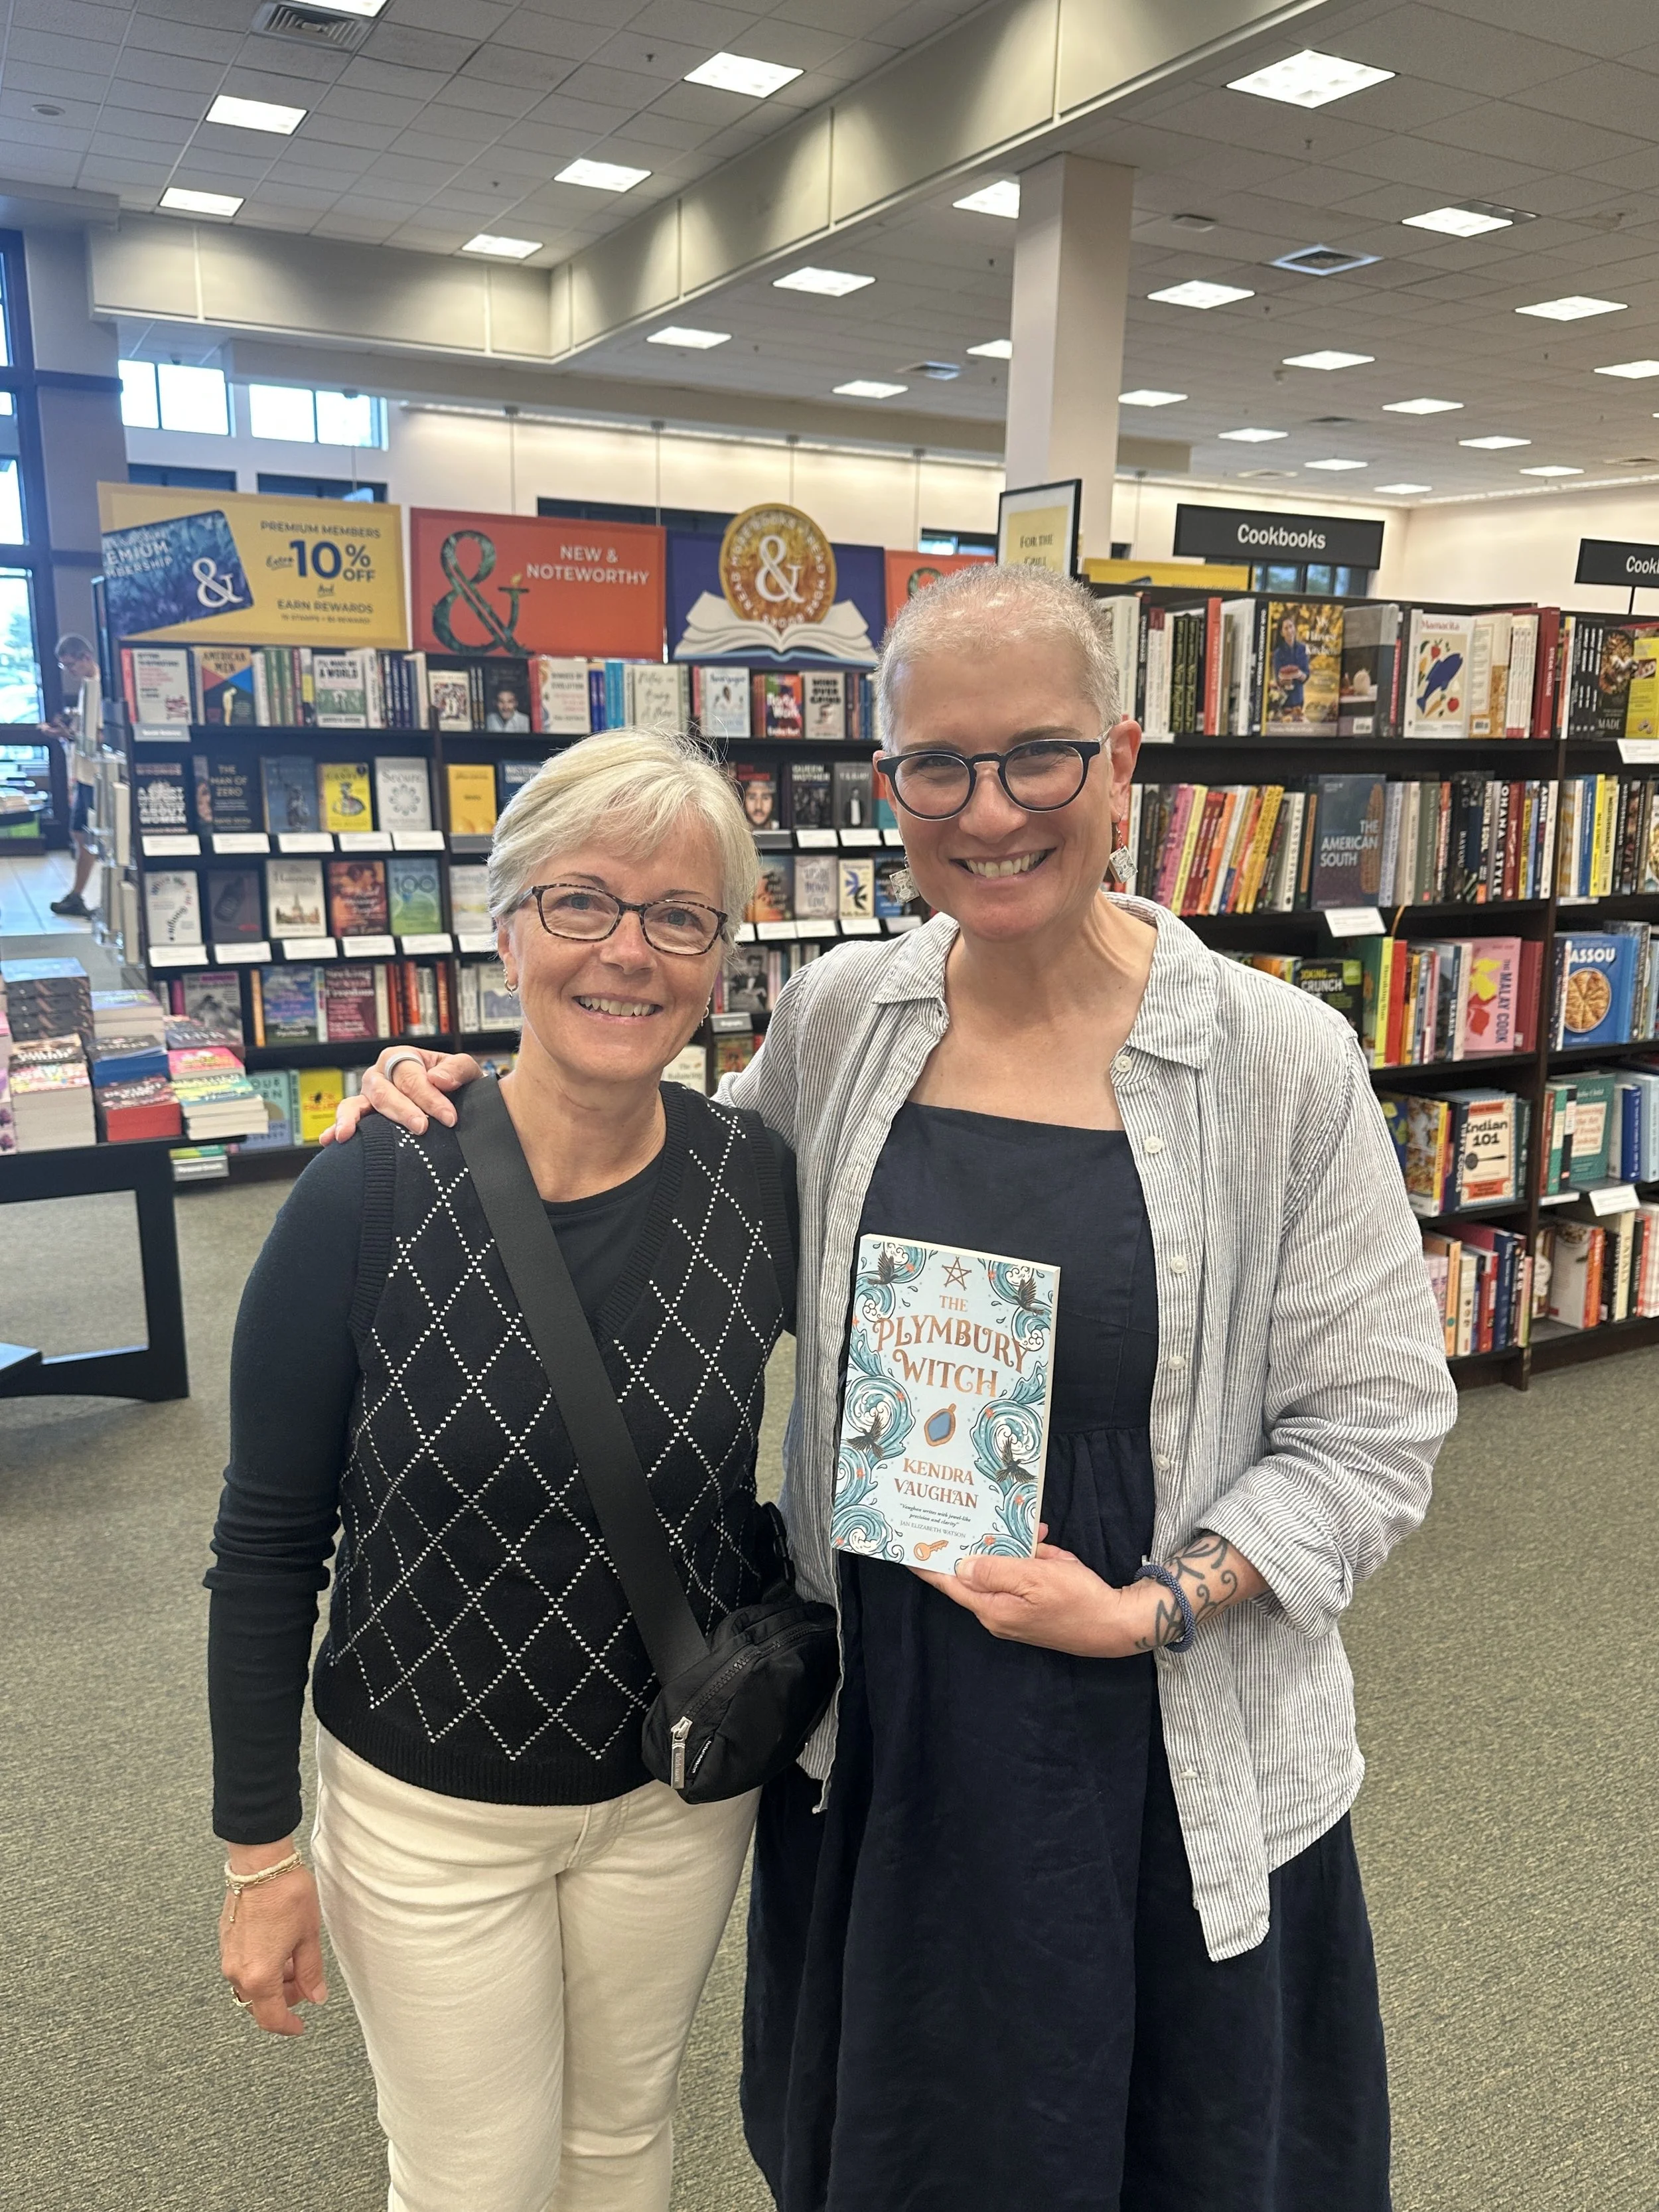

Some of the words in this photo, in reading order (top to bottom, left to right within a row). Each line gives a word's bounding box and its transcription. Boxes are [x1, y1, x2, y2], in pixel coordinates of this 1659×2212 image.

[260, 520, 319, 534] PREMIUM
[321, 524, 381, 539] MEMBERS
[1238, 523, 1326, 550] Cookbooks
[1019, 536, 1037, 548] FOR
[1039, 534, 1052, 546] THE
[105, 541, 170, 565] EMIUM
[561, 544, 602, 562] NEW
[607, 550, 618, 563] &
[105, 555, 173, 579] MBERSHIP
[1626, 555, 1659, 574] Cook
[343, 568, 376, 583] OFF
[526, 564, 650, 585] NOTEWORTHY
[277, 599, 311, 611] EARN
[314, 601, 374, 614] REWARDS
[1421, 619, 1460, 630] Mamacita
[1598, 718, 1621, 730] MADE
[1497, 785, 1510, 839] OHANA
[1360, 820, 1378, 834] THE
[1321, 836, 1378, 850] AMERICAN
[1320, 853, 1358, 867] SOUTH
[1493, 851, 1504, 897] STYLE
[1570, 947, 1616, 963] ASSOU
[1301, 968, 1327, 980] OKING
[1301, 980, 1343, 992] CRUNCH
[1498, 972, 1512, 1010] MALAY
[1496, 1013, 1510, 1043] COOK
[1466, 1118, 1508, 1134] Indian
[1473, 1132, 1500, 1147] 101
[1456, 1154, 1465, 1193] COOKS
[939, 1295, 968, 1312] THE
[872, 1314, 1030, 1374] PLYMBURY
[892, 1349, 998, 1398] WITCH
[902, 1457, 974, 1486] KENDRA
[894, 1478, 979, 1509] VAUGHAN
[948, 1514, 972, 1522] jewel-like
[911, 1522, 942, 1533] ELIZABETH
[942, 1528, 966, 1538] WATSON
